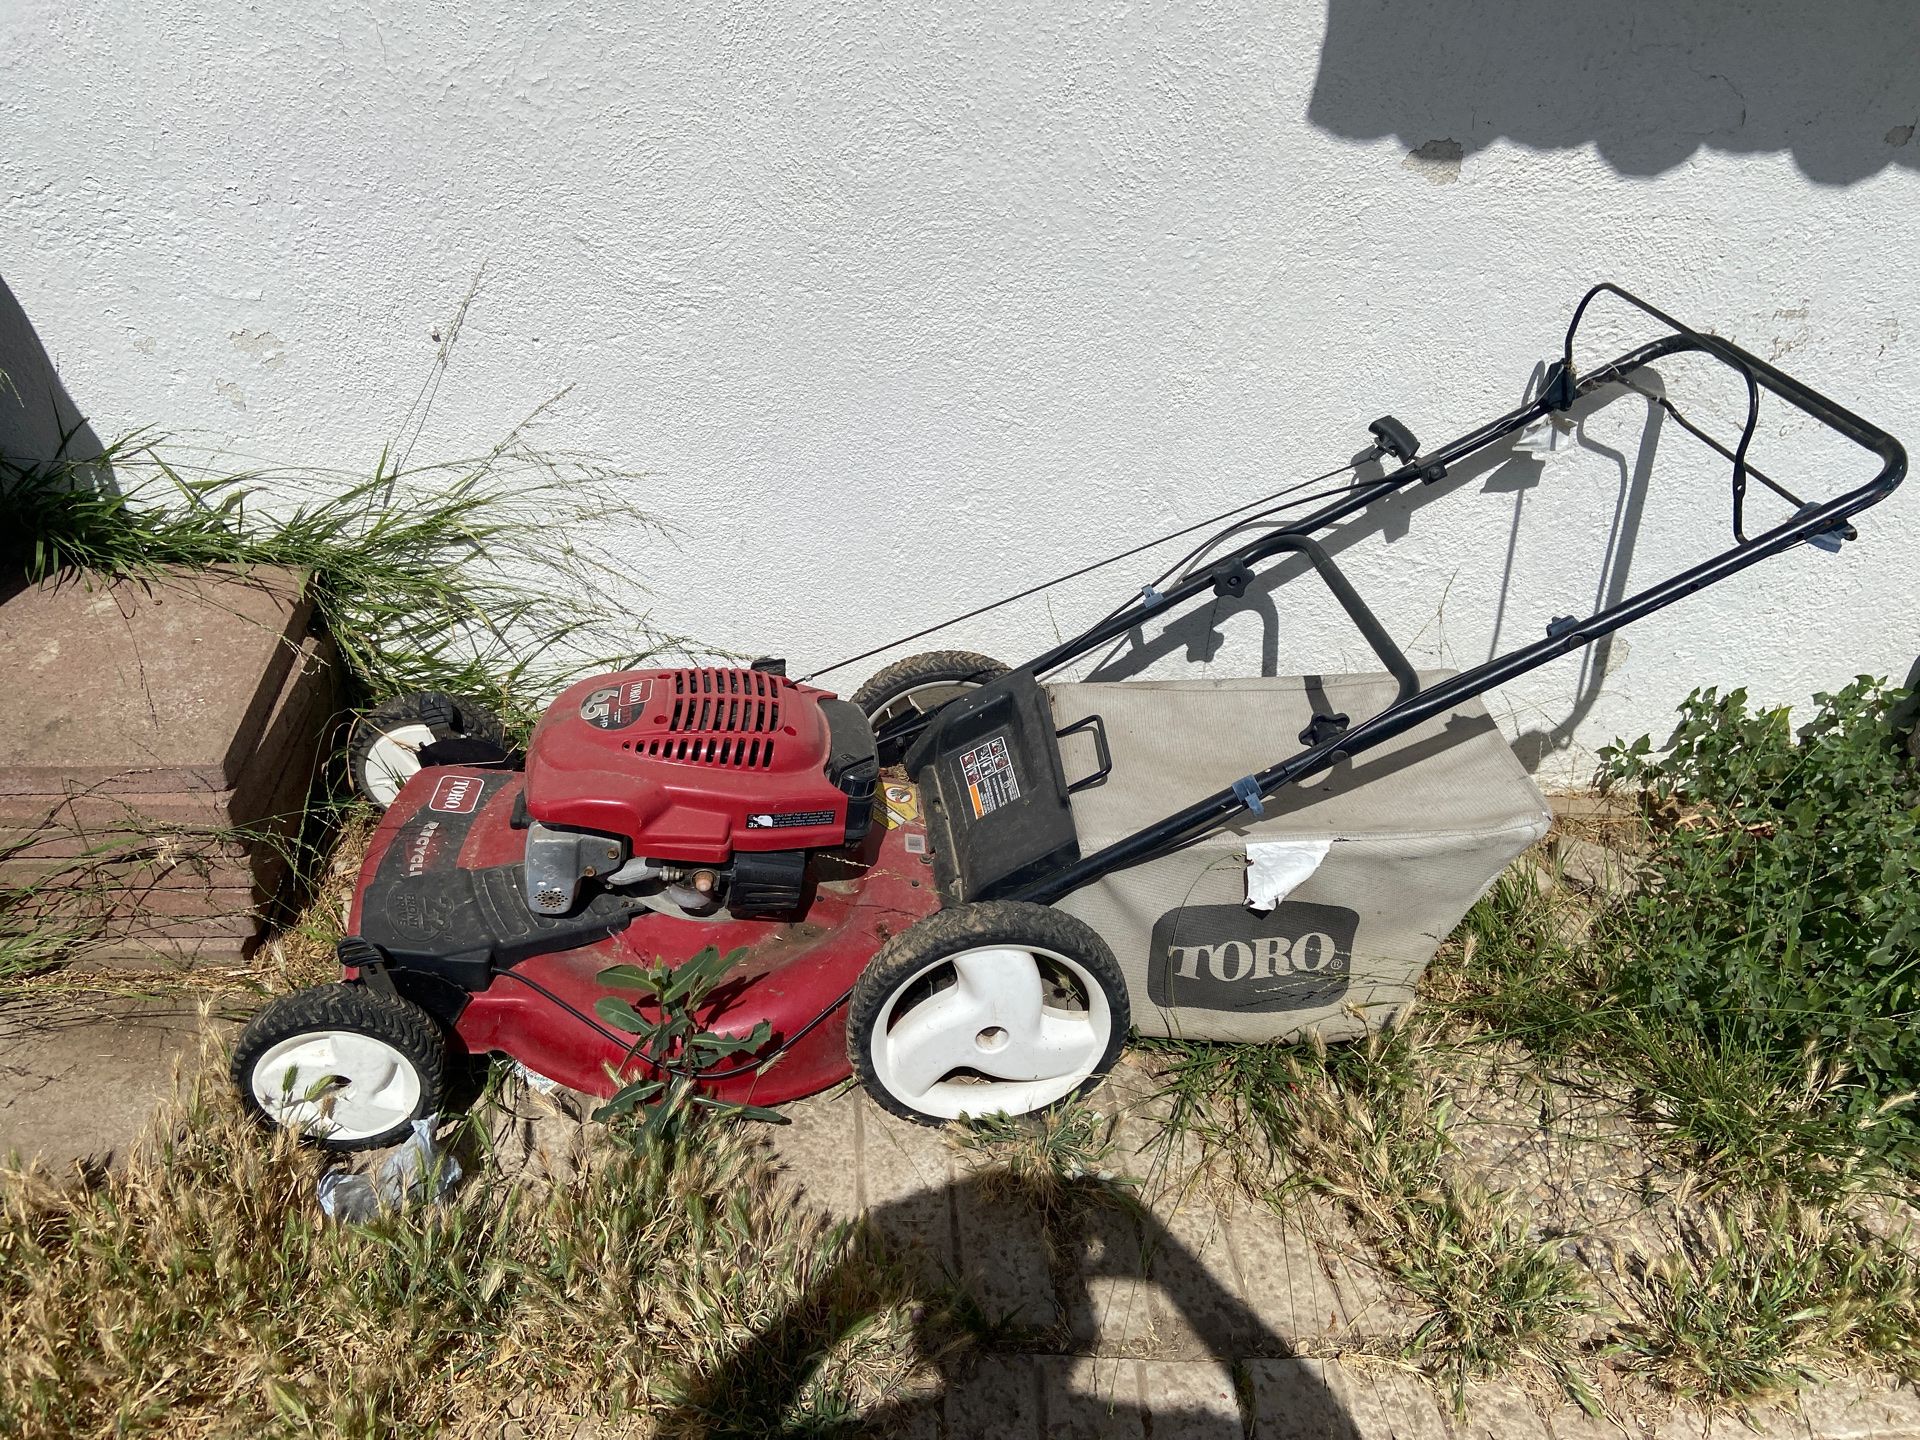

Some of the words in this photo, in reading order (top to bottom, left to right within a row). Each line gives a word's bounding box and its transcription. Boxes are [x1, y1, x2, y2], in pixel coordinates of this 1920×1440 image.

[629, 682, 643, 702] TORO
[599, 715, 609, 728] HP
[444, 780, 470, 809] TORO
